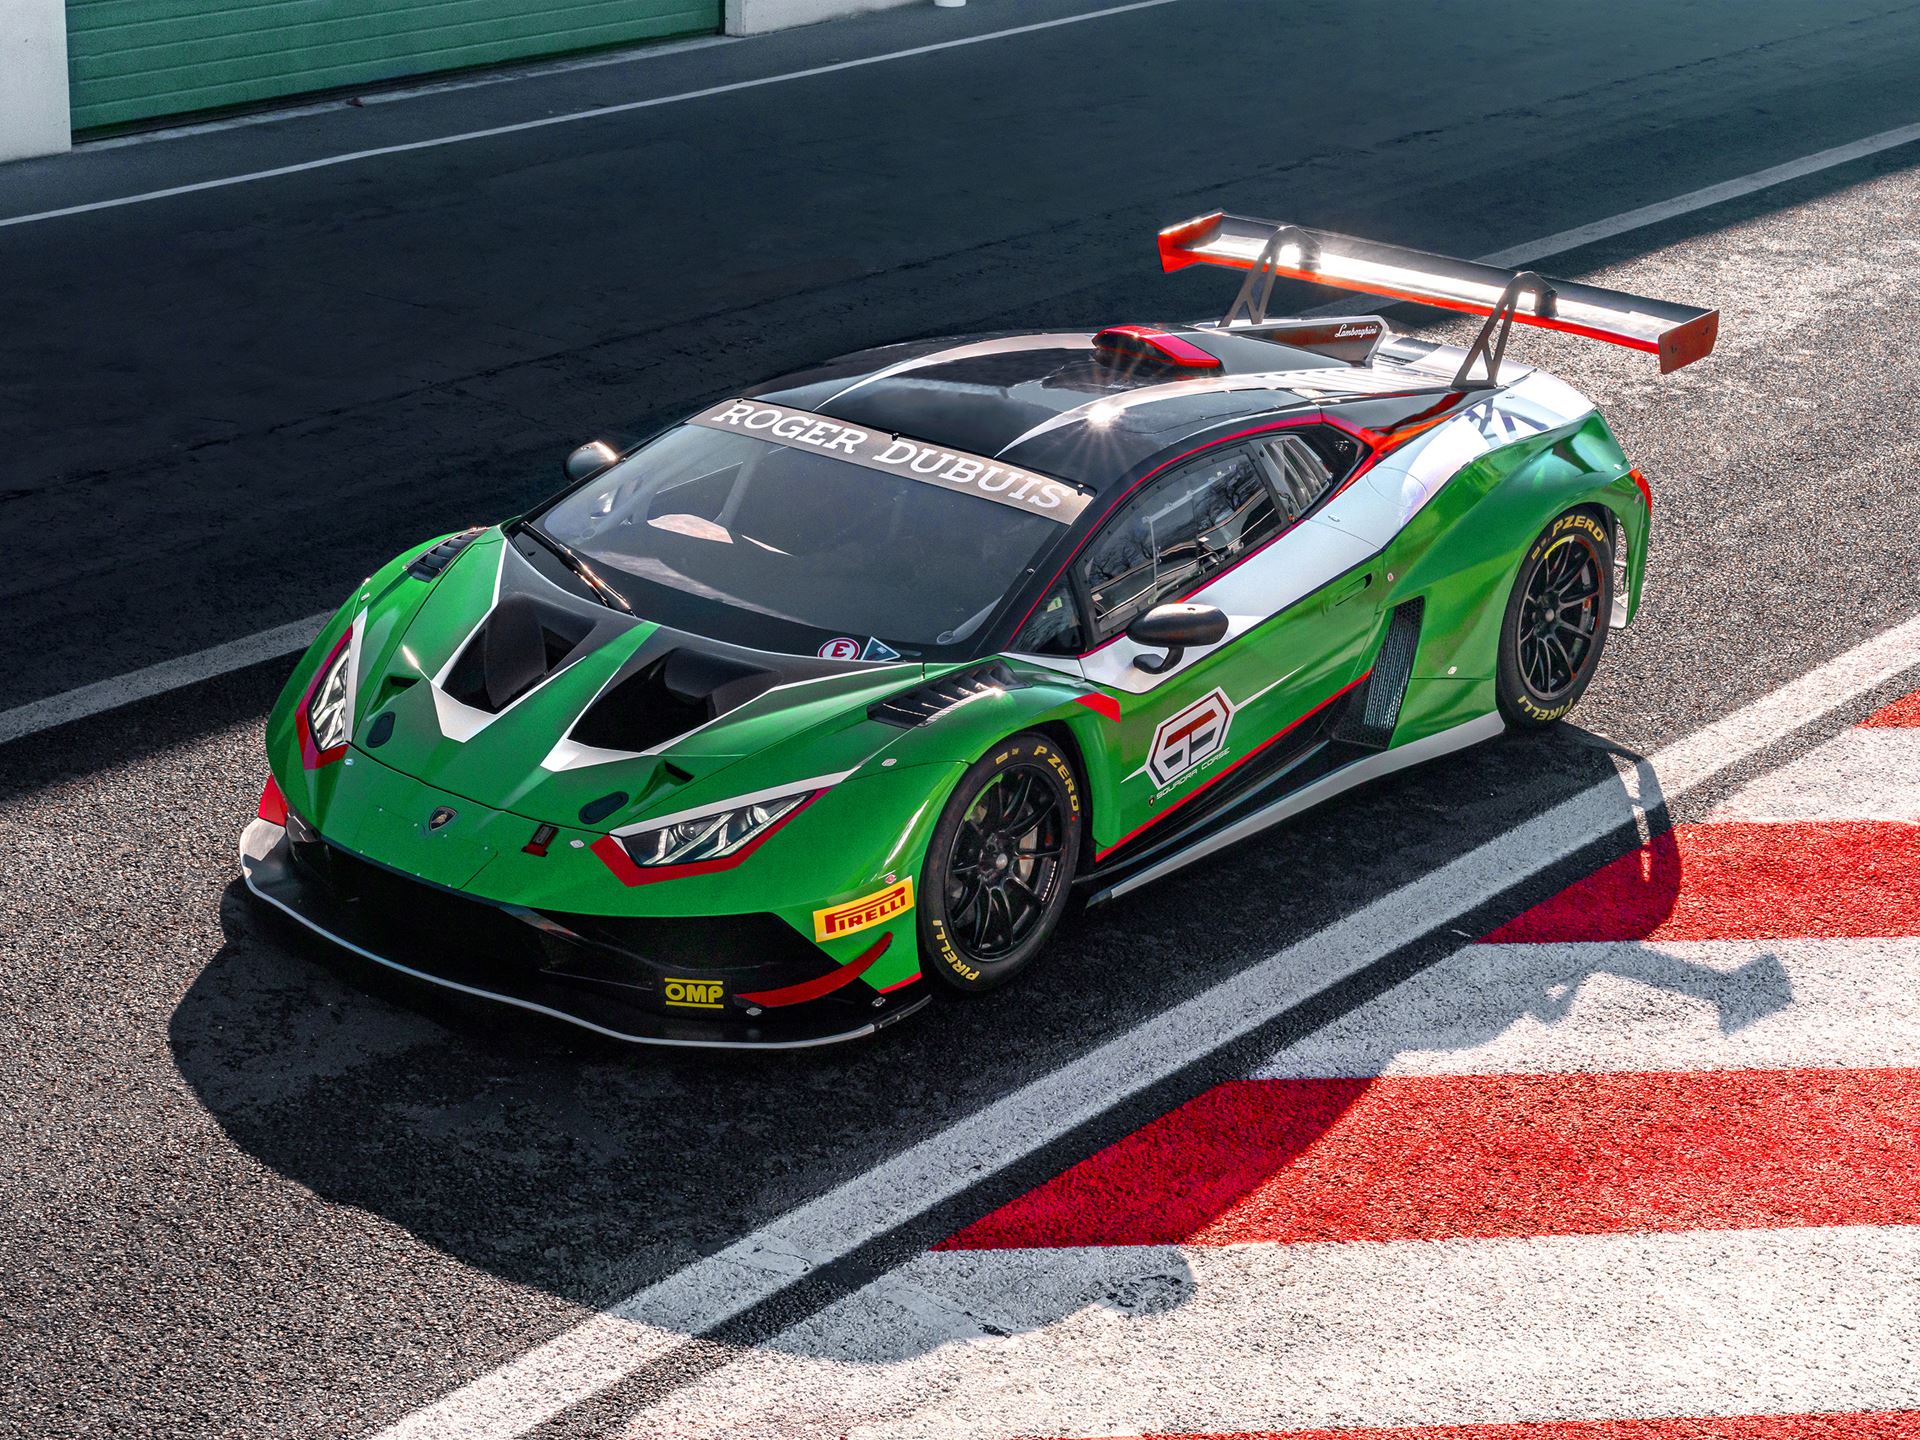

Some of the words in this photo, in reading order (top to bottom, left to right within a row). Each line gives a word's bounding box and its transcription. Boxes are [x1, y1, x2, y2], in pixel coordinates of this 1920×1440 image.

[1334, 323, 1378, 338] Lamborghini
[711, 403, 869, 454] ROGER
[872, 439, 1072, 509] DUBUIS
[831, 642, 850, 657] E
[1156, 768, 1198, 799] SQUADRA
[1201, 747, 1230, 770] CORSE
[825, 886, 906, 934] PIRELLI
[932, 919, 981, 982] PIRELLI
[665, 983, 724, 1003] OMP
